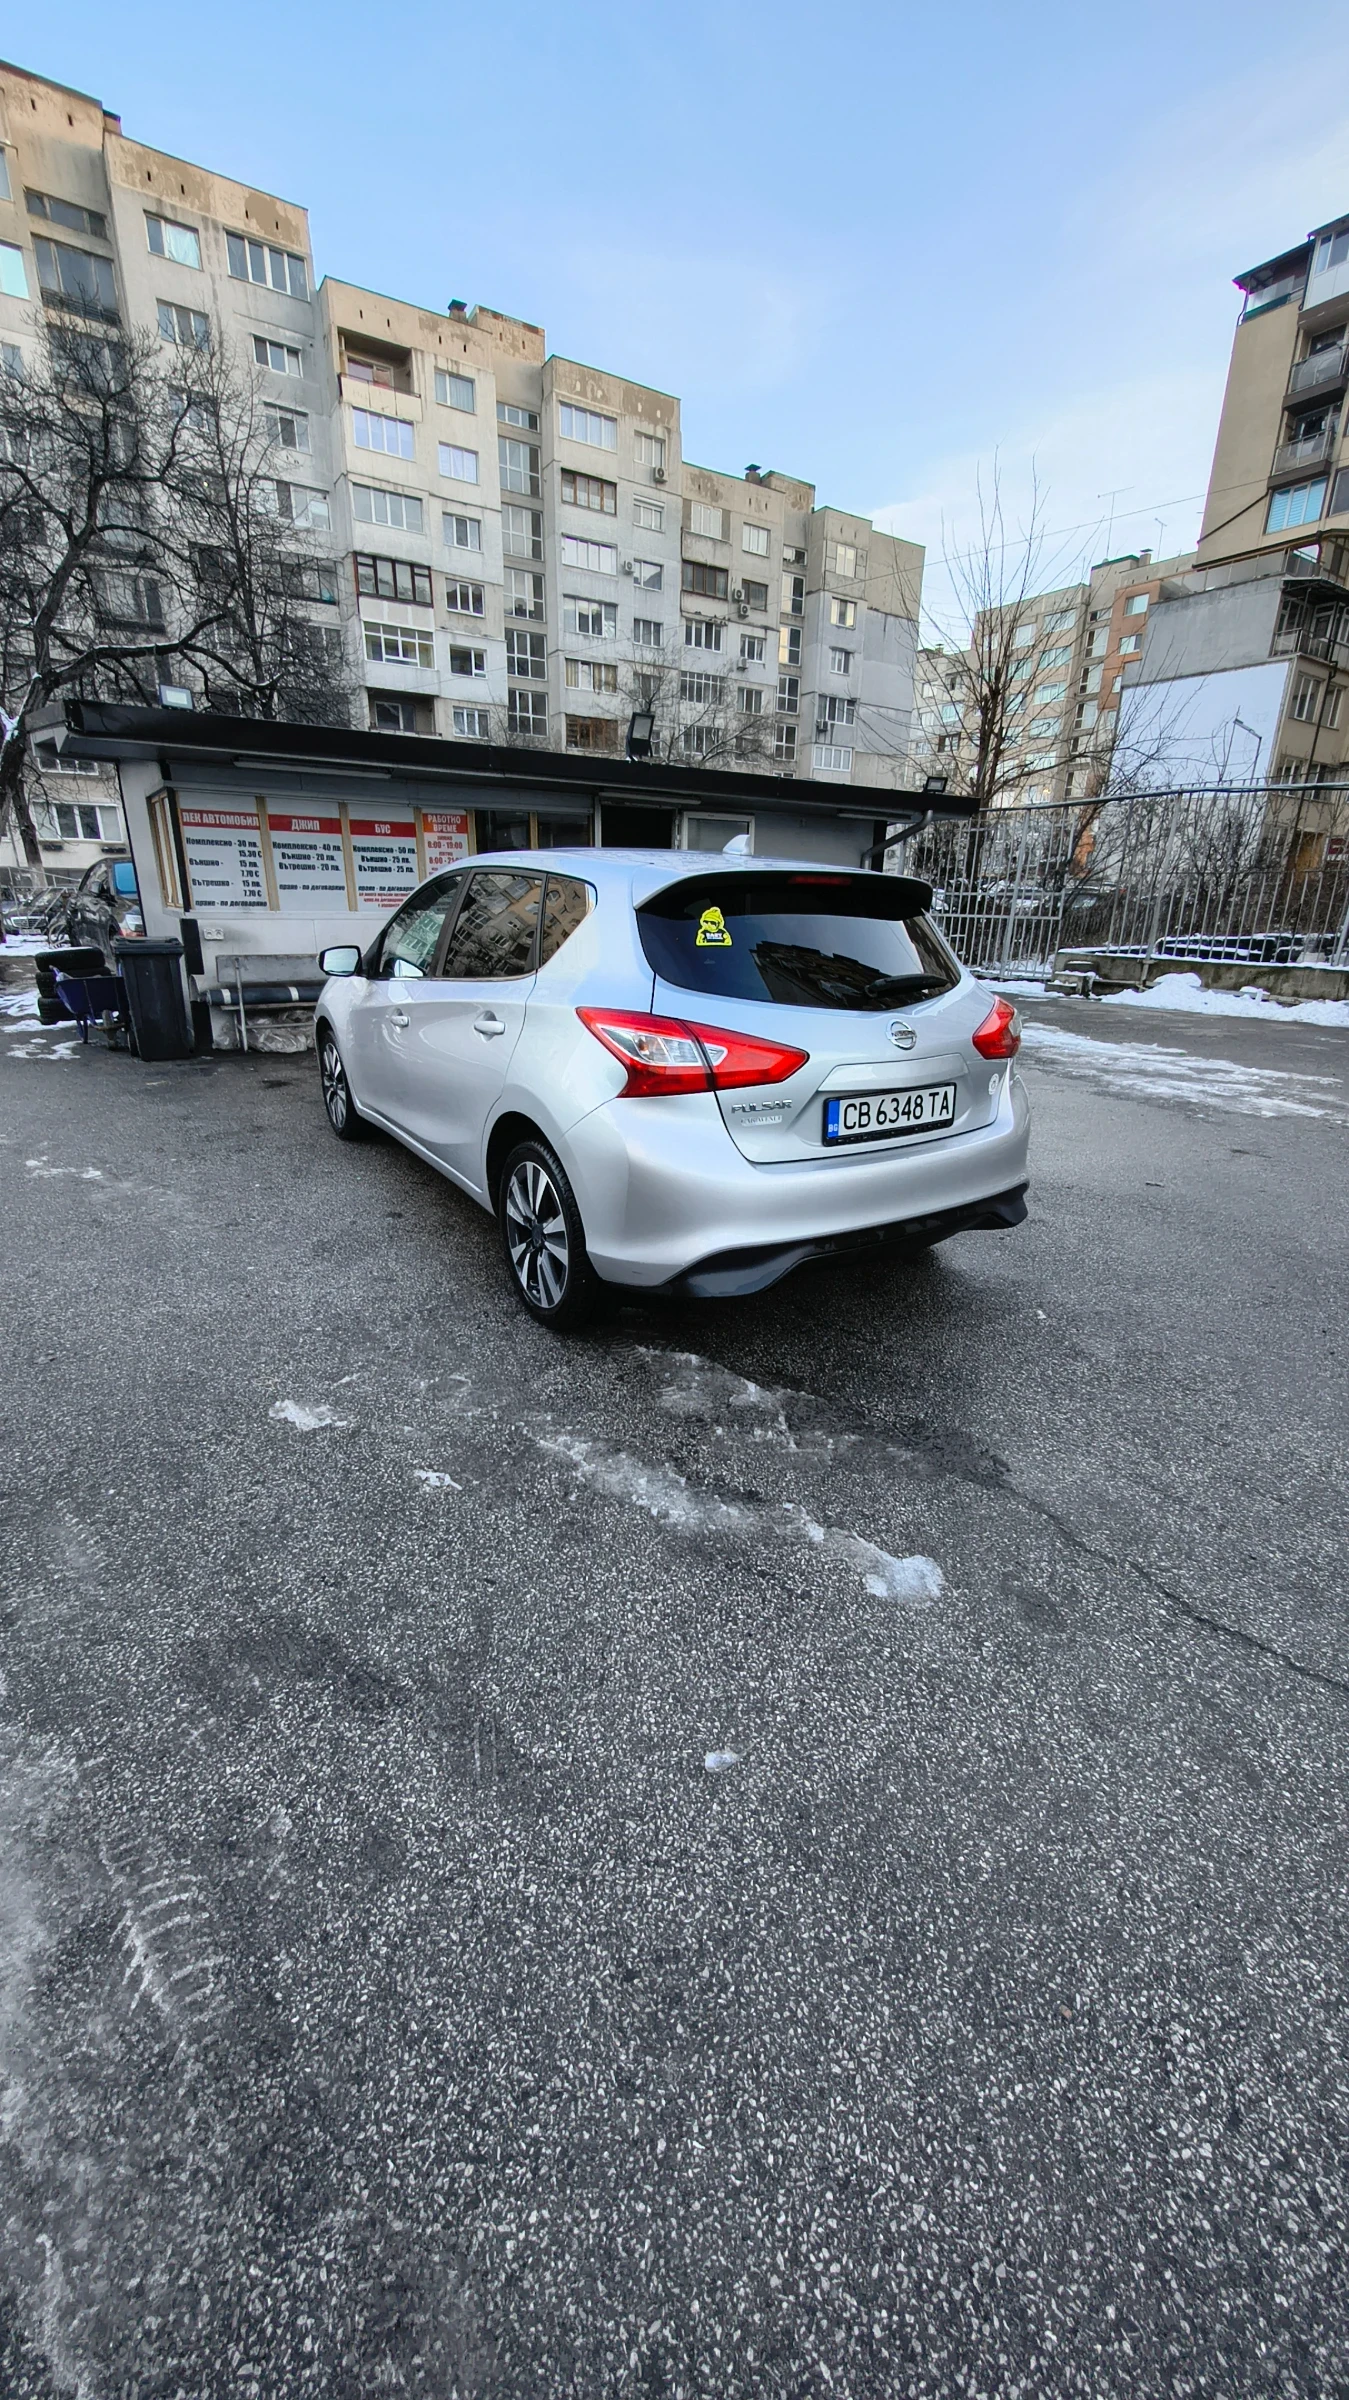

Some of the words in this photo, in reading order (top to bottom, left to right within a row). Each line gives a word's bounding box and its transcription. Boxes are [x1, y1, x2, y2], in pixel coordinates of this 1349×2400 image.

[182, 812, 201, 823] ЛЕК
[203, 813, 259, 827] АВТОМОБИЛ
[427, 814, 461, 824] РАБОТНО
[292, 819, 320, 831] ДЖИП
[375, 824, 391, 834] БУС
[433, 824, 457, 833] ВРЕМЕ
[238, 840, 246, 848] 30
[398, 846, 406, 854] 50
[316, 853, 324, 861] 20
[321, 863, 329, 871] 20
[731, 1099, 793, 1114] PULSAR
[843, 1101, 871, 1130] CB
[876, 1094, 924, 1126] 6348
[928, 1090, 950, 1118] TA
[828, 1124, 839, 1133] BG
